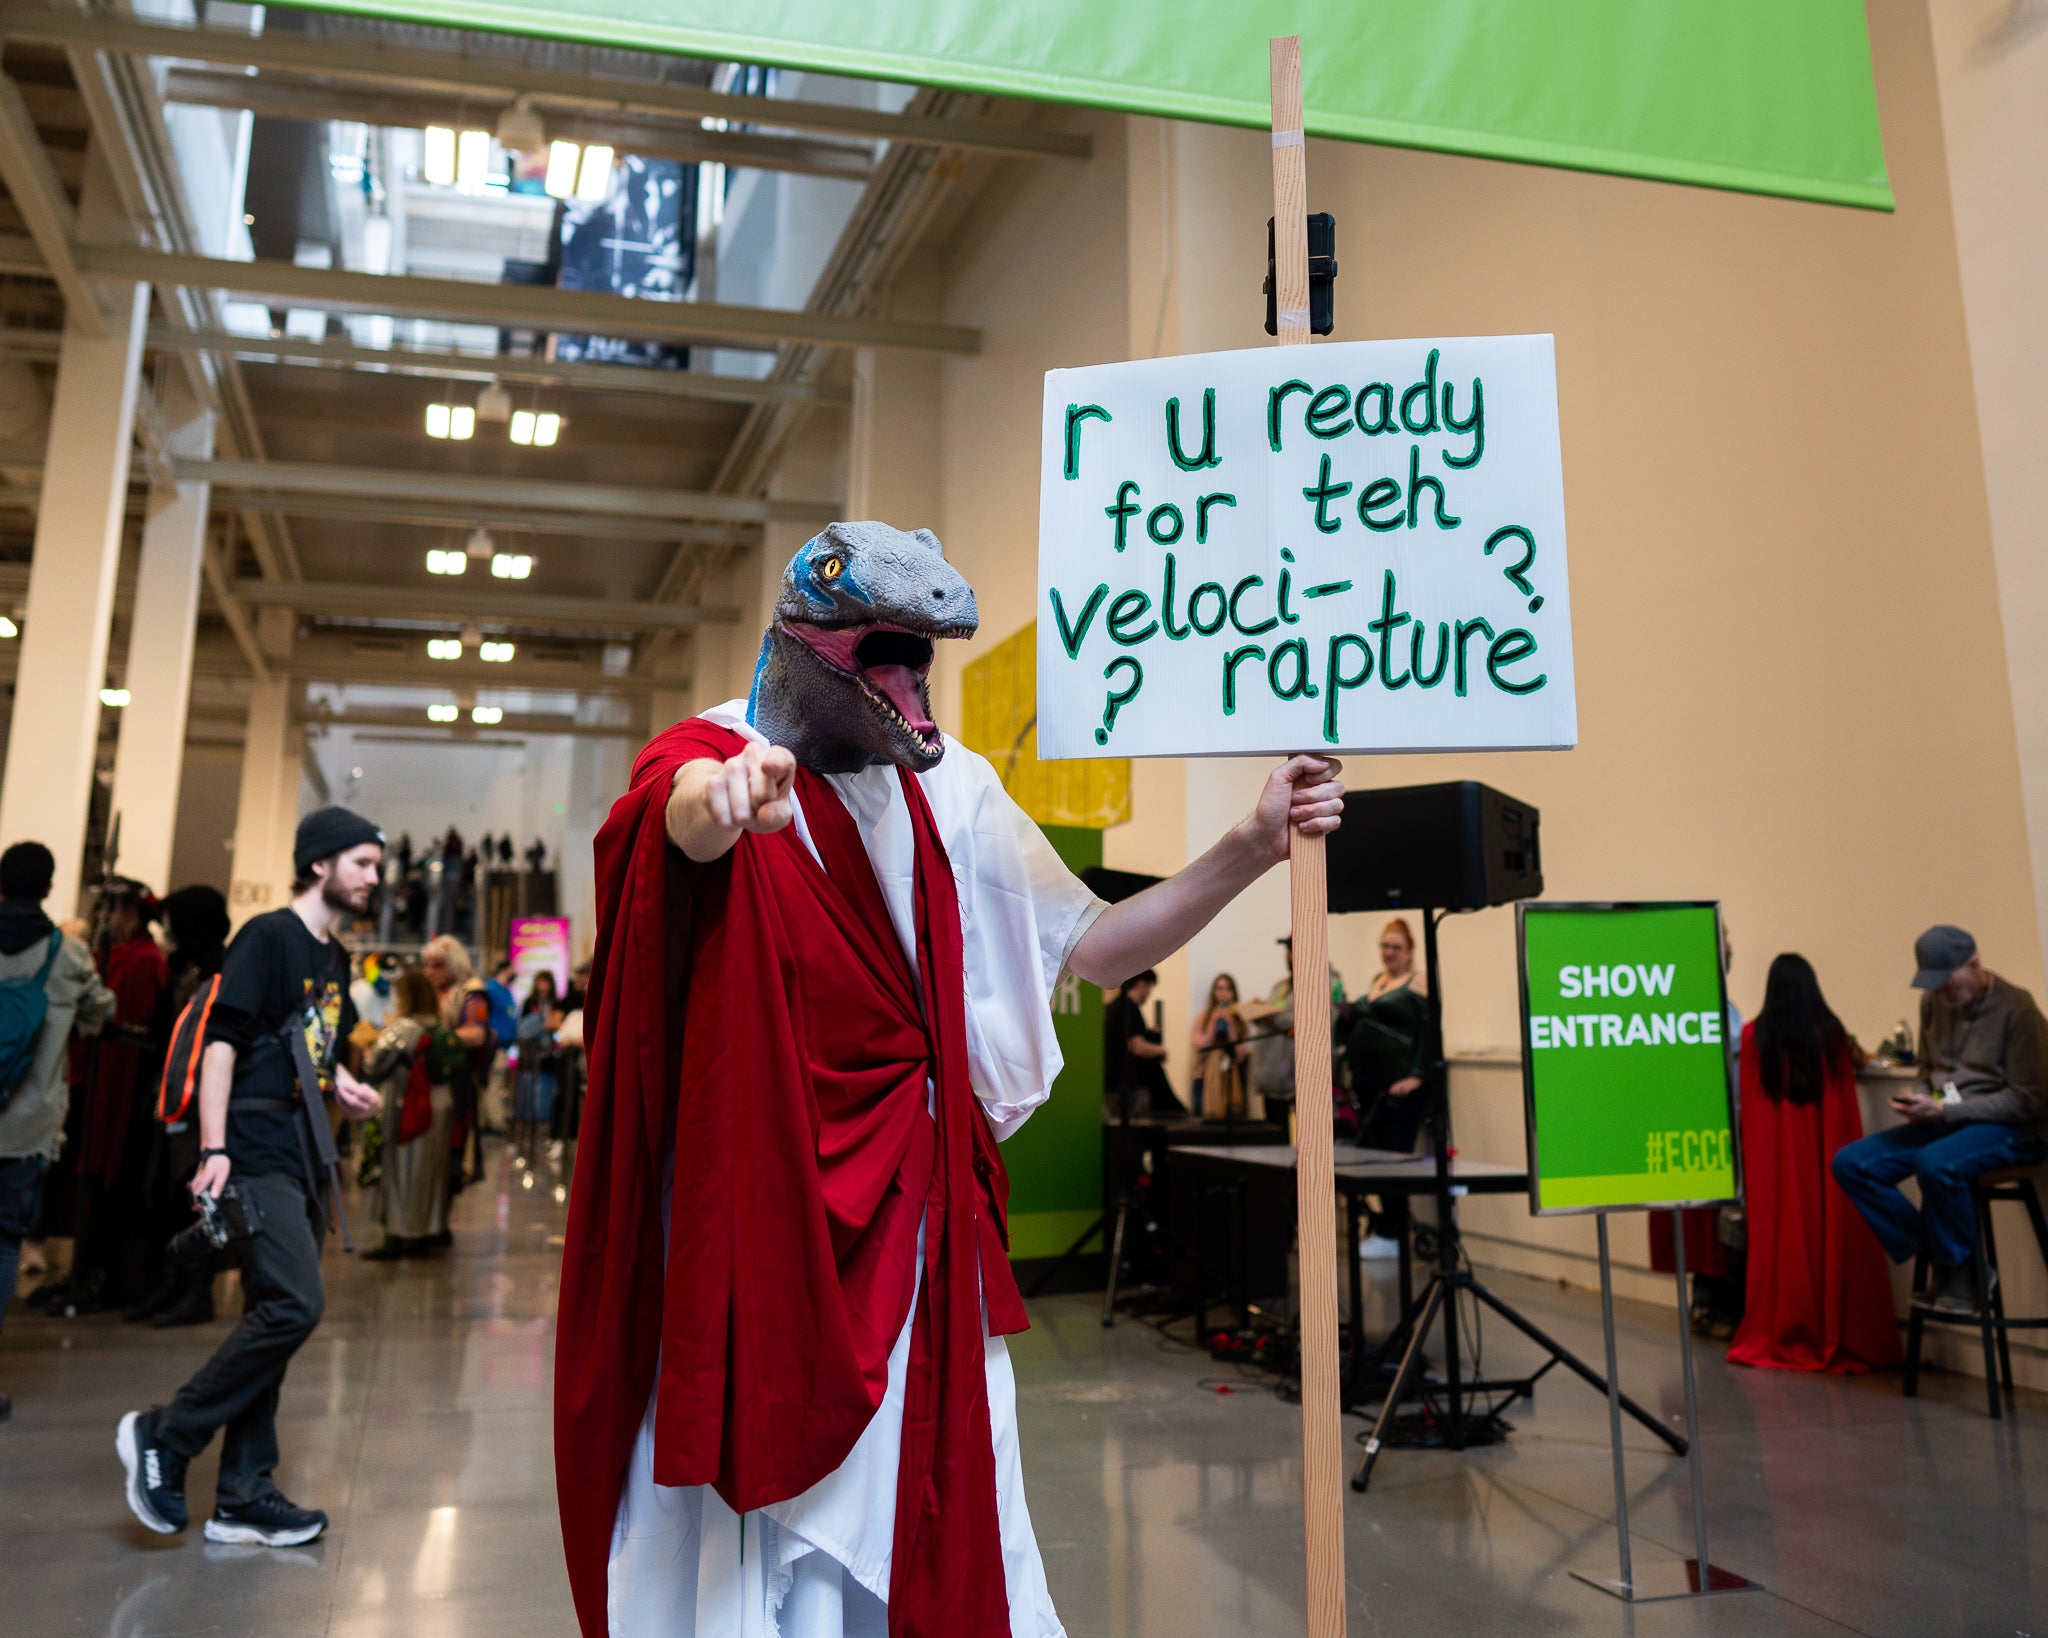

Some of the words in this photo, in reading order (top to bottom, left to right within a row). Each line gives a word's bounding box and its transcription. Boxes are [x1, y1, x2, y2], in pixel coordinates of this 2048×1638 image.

[1063, 403, 1113, 480] r
[1165, 387, 1223, 472] u
[1266, 348, 1486, 470] ready
[1104, 480, 1237, 553] for
[1302, 444, 1462, 534] teh
[1484, 524, 1545, 614] ?
[1094, 655, 1144, 746] ?
[1221, 568, 1548, 744] rapture
[1529, 1011, 1722, 1049] ENTRANCE
[1559, 964, 1676, 998] SHOW
